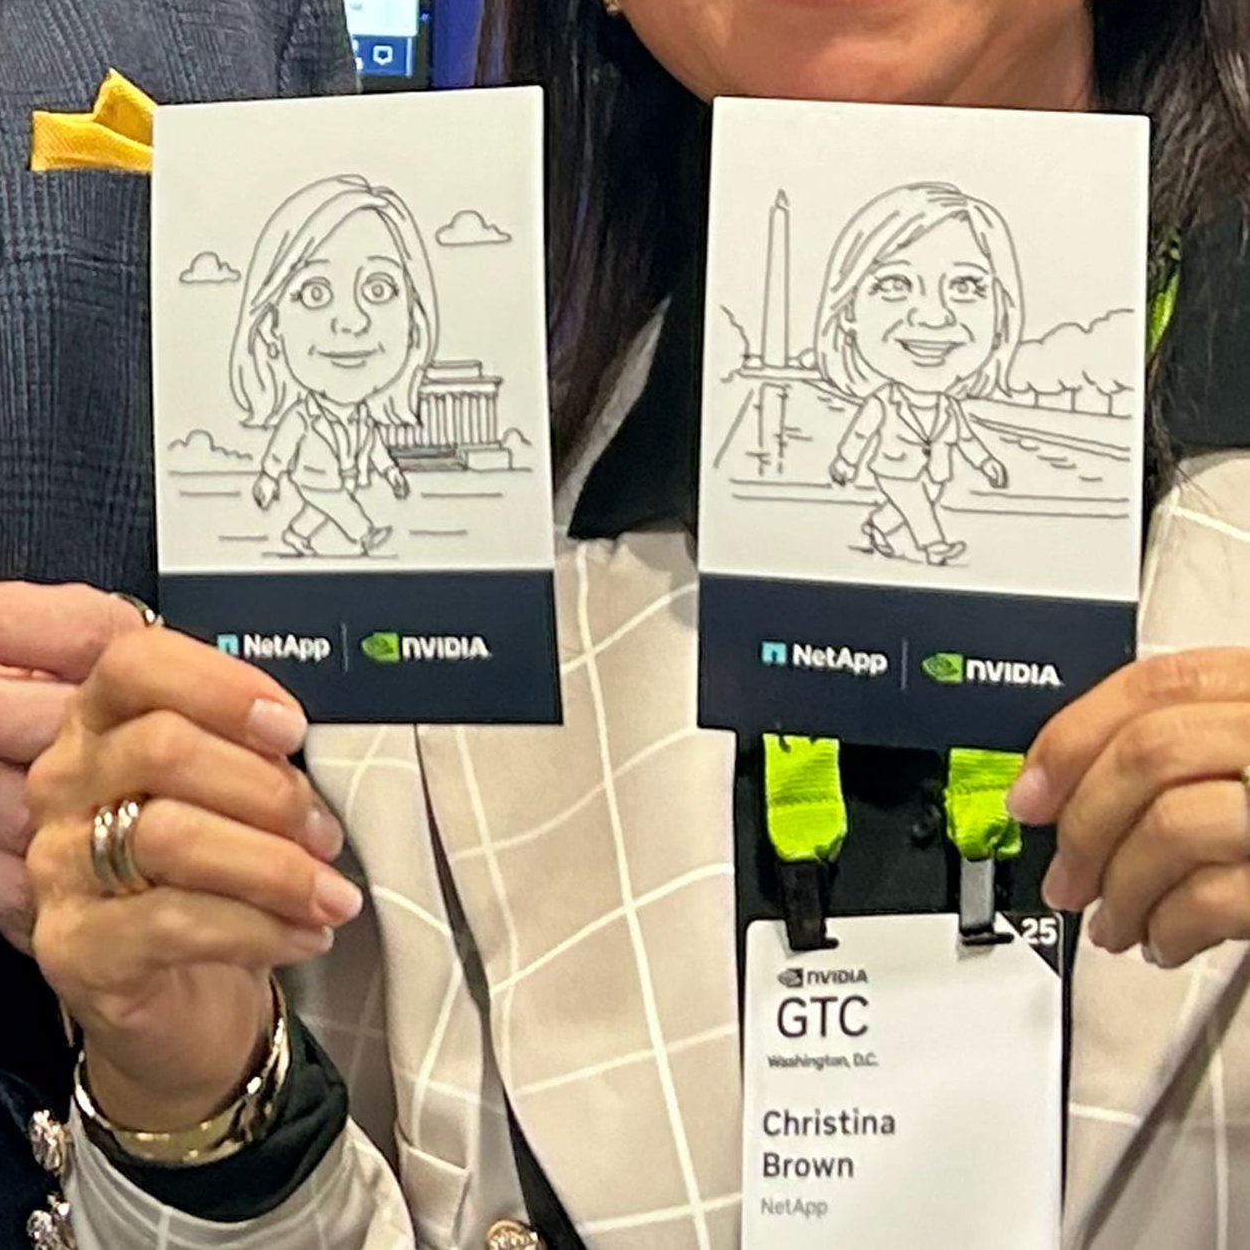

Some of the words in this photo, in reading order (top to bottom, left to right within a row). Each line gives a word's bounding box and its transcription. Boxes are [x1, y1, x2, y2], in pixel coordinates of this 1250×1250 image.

[243, 634, 332, 662] NetApp
[792, 643, 888, 676] NetApp
[1021, 917, 1058, 945] 25
[777, 995, 870, 1038] GTC
[762, 1108, 897, 1137] Christina
[762, 1152, 854, 1178] Brown
[760, 1197, 828, 1218] NetApp
